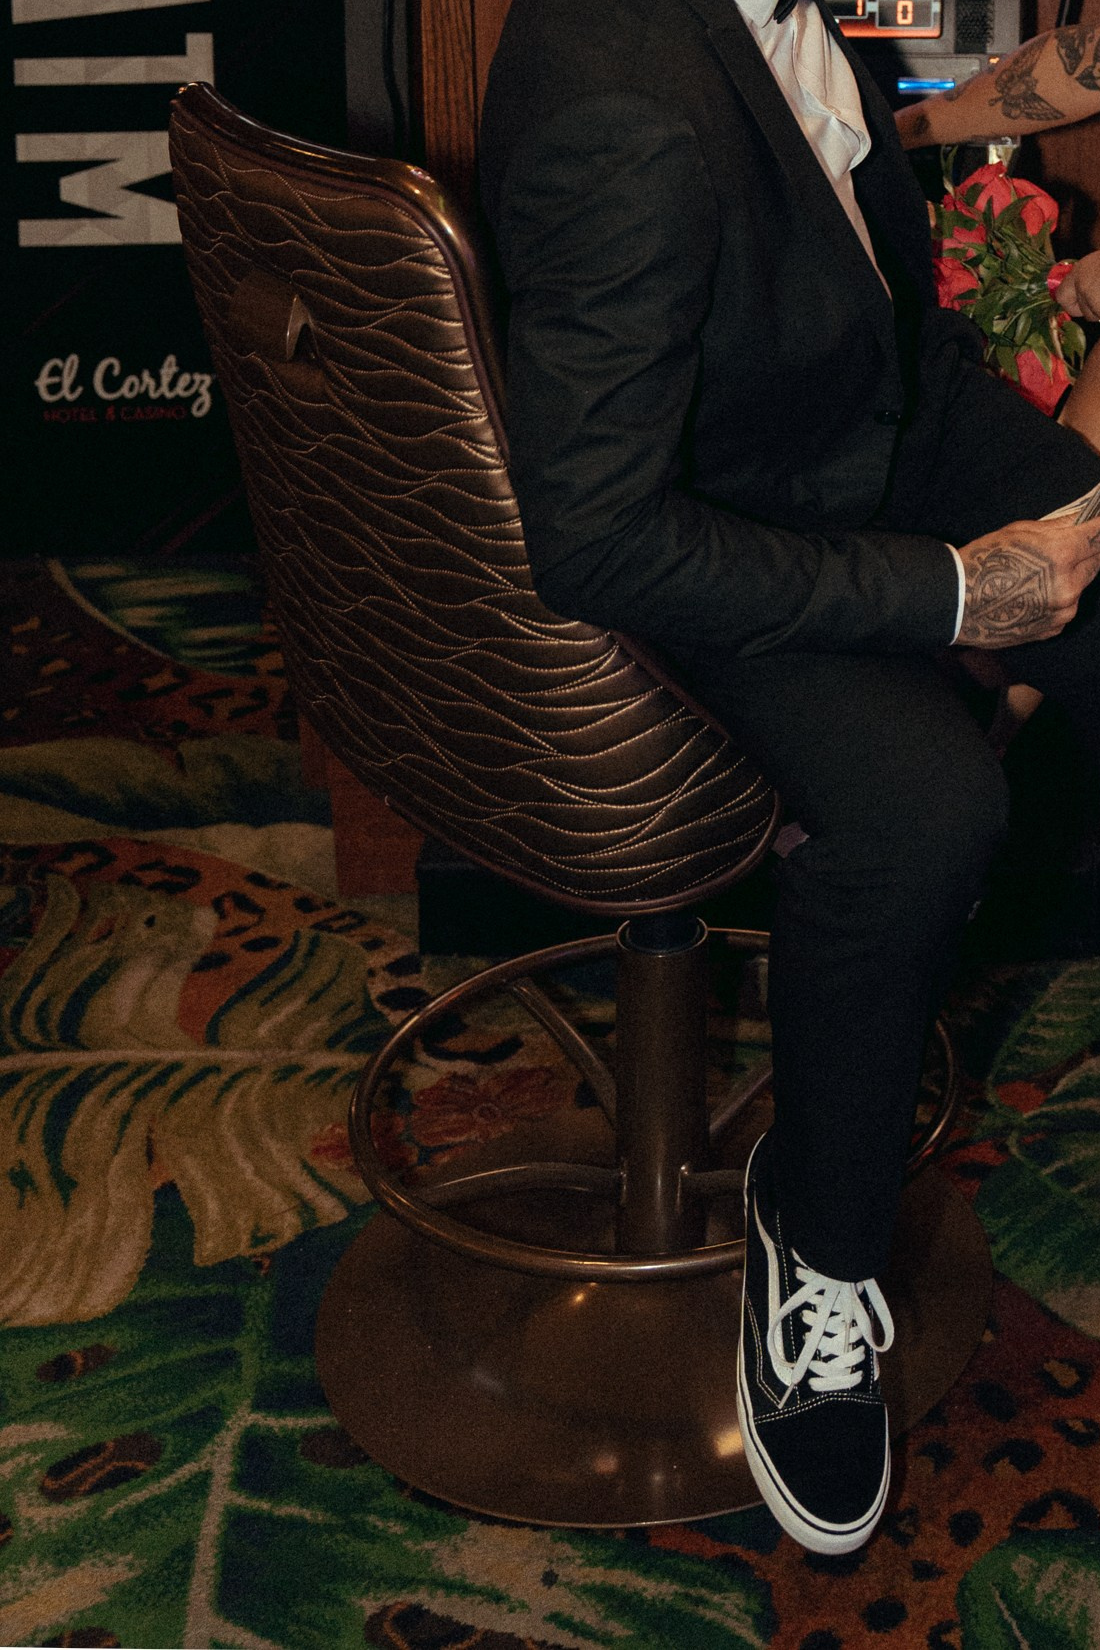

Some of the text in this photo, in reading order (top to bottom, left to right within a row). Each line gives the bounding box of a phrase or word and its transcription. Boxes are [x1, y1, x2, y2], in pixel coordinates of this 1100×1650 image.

[896, 0, 914, 25] 0
[34, 353, 212, 418] El Cortez
[43, 407, 98, 423] HOTEL
[120, 406, 187, 421] CASINO
